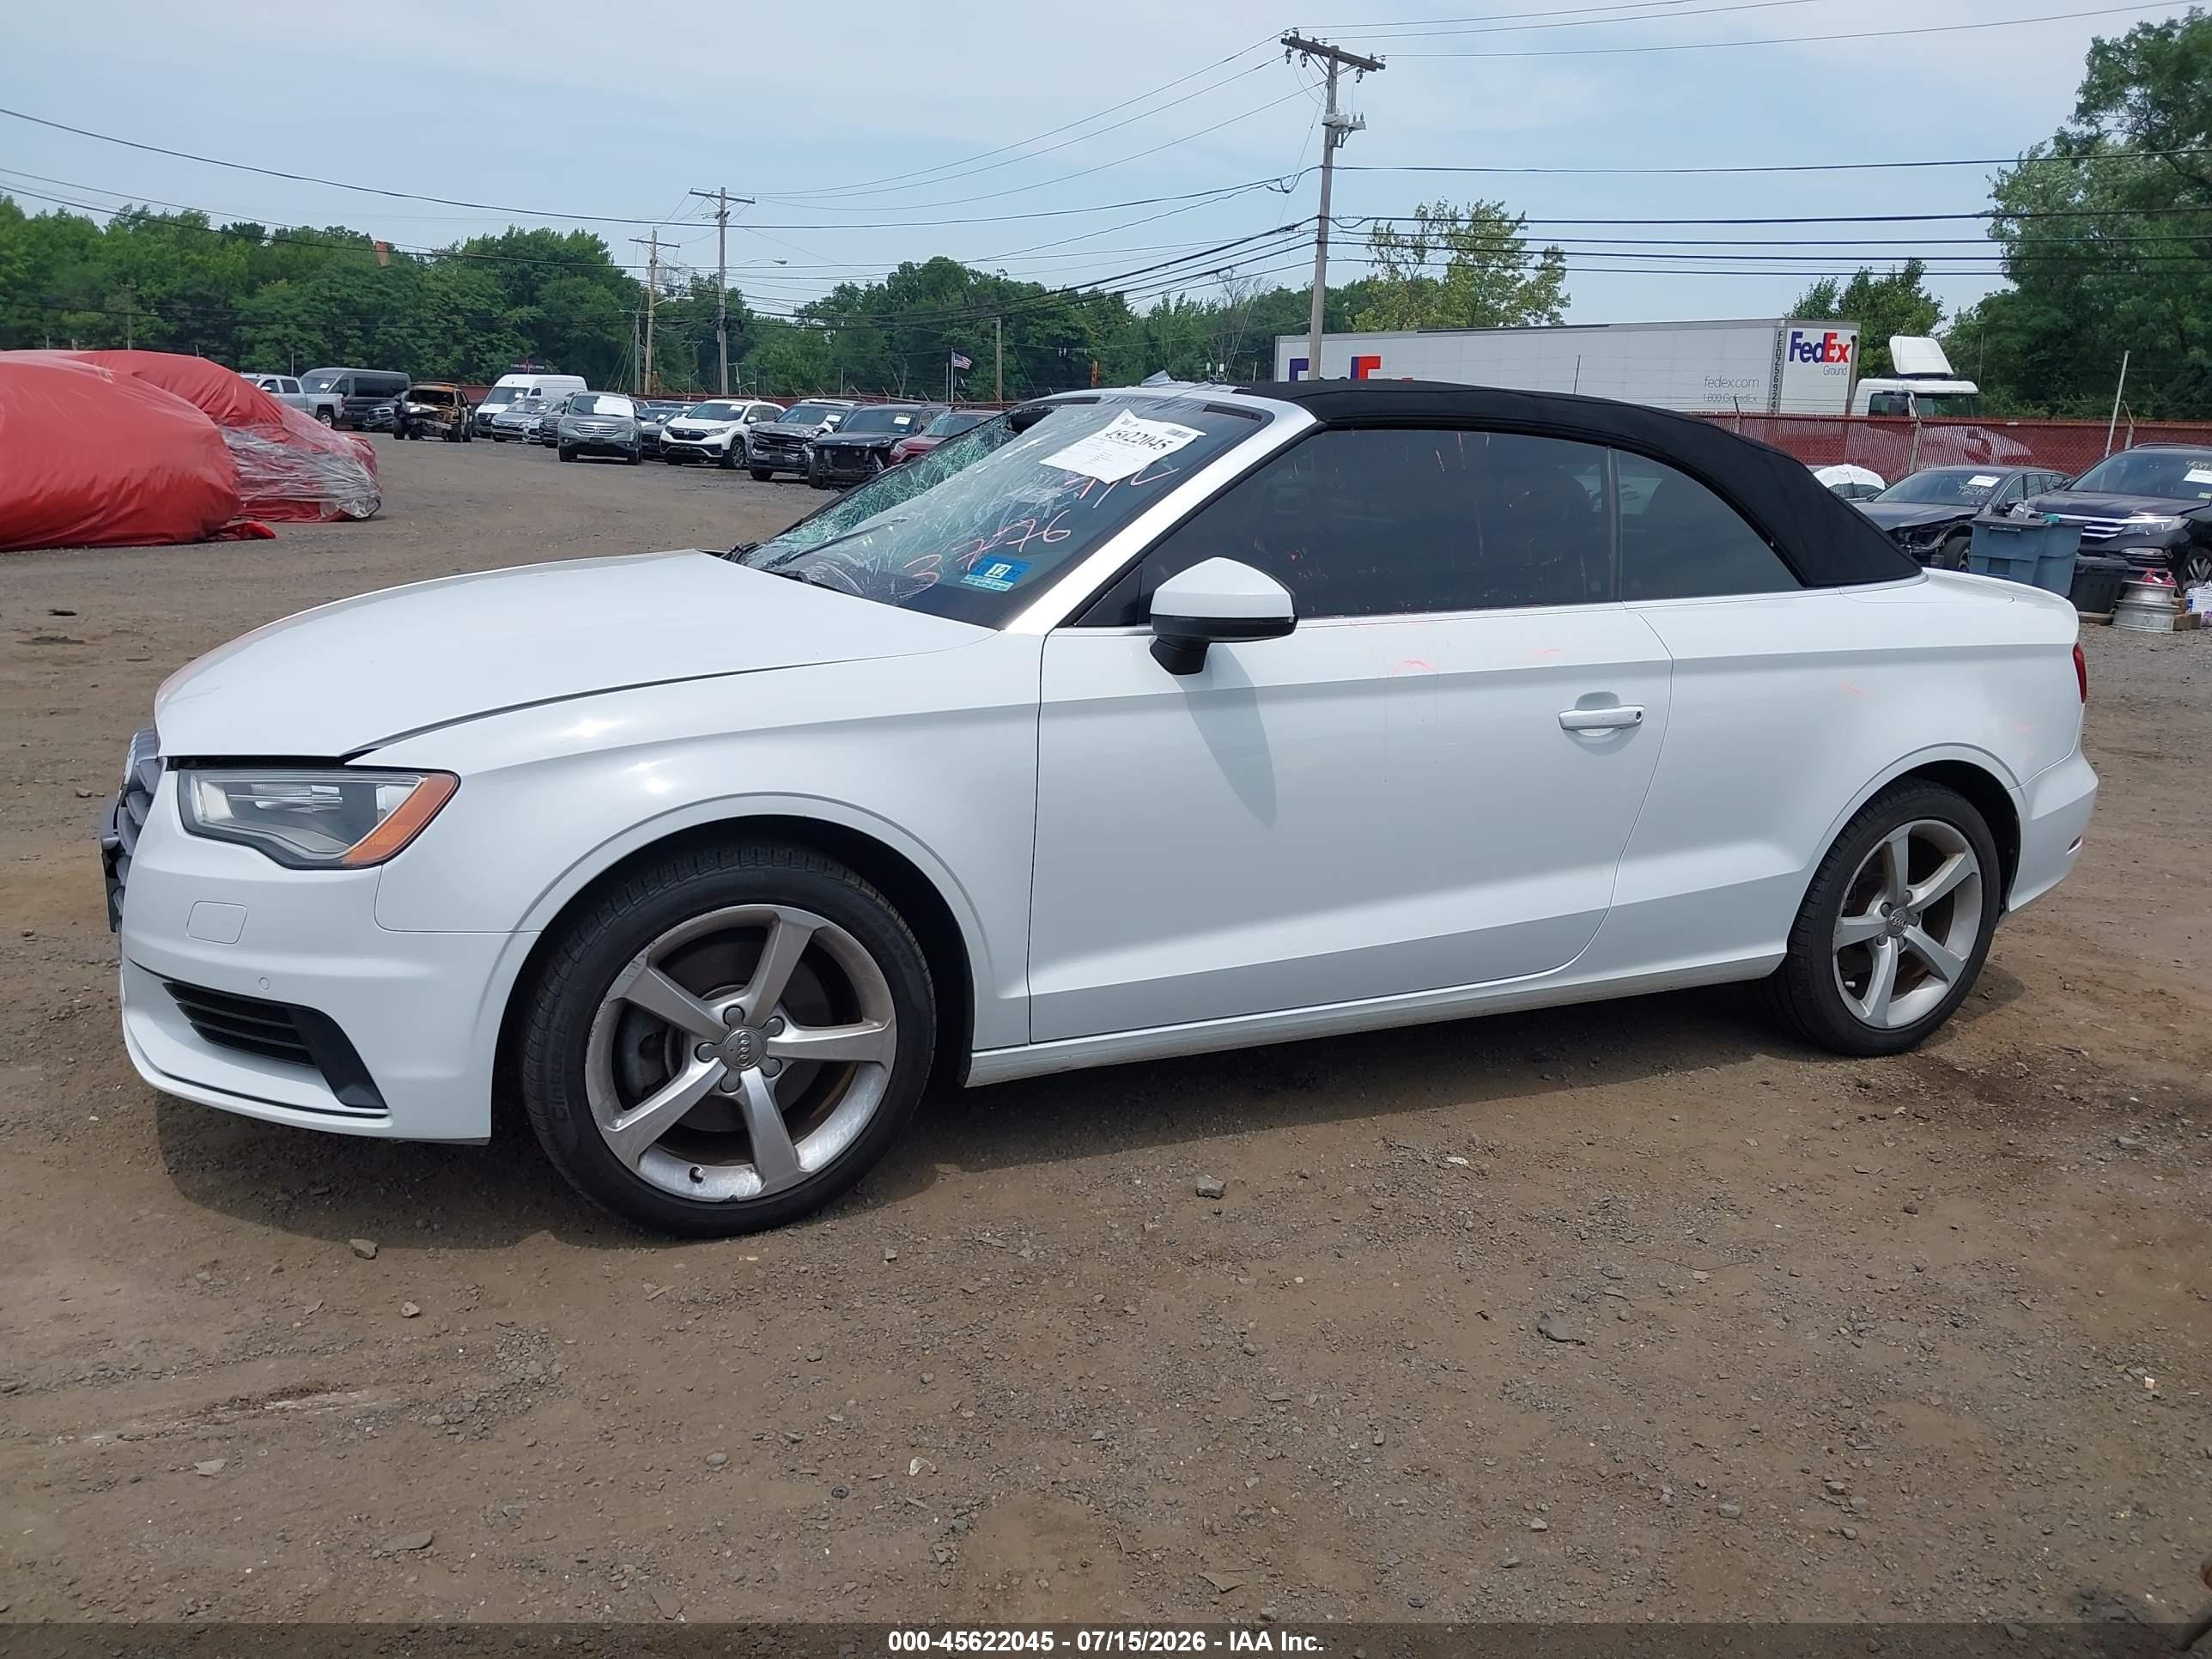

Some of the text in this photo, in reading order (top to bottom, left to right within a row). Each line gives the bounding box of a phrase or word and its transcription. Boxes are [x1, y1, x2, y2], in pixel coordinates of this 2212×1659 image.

[1790, 331, 1850, 363] FedEx
[1823, 365, 1847, 375] Ground
[1704, 375, 1759, 388] fedex.com
[1104, 429, 1173, 450] 45622045
[988, 565, 1009, 576] 12
